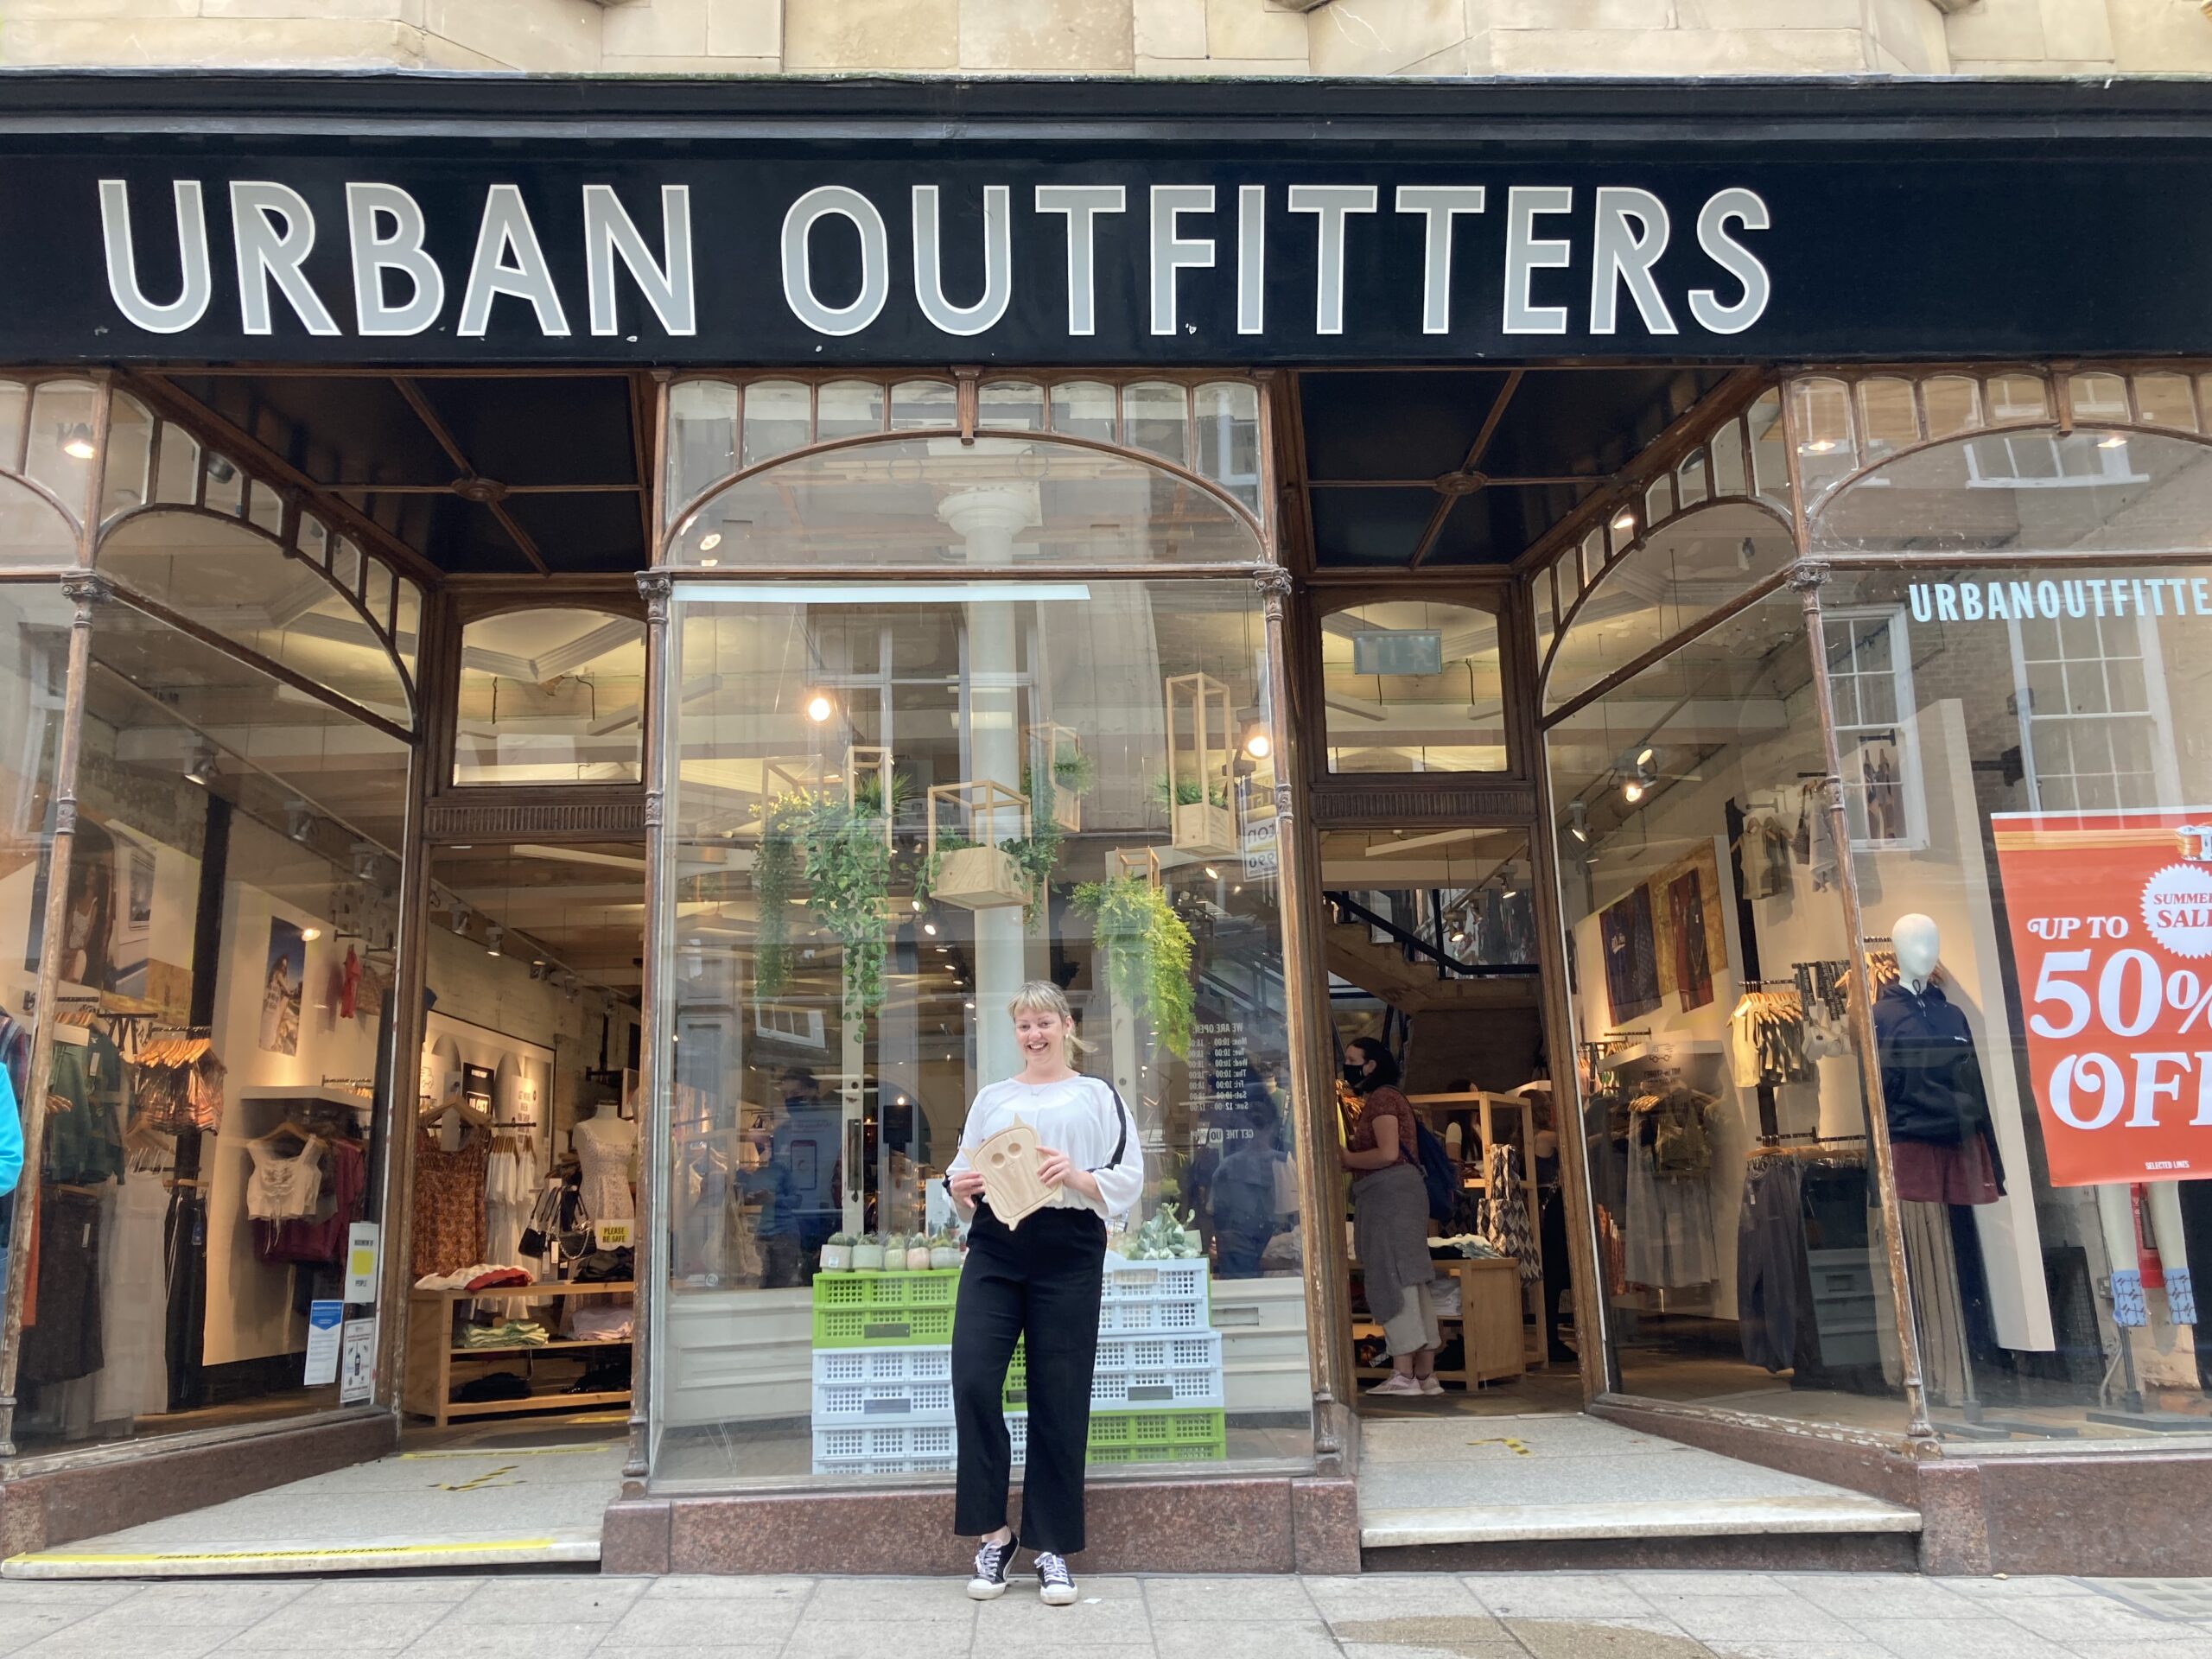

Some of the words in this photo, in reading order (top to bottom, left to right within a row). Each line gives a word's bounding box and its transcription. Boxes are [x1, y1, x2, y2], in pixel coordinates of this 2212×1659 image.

[98, 178, 697, 338] URBAN
[779, 184, 1773, 336] OUTFITTERS
[1909, 577, 2212, 623] URBANOUTFITTE
[2153, 893, 2212, 905] SUMME
[2027, 917, 2081, 940] UP
[2087, 916, 2129, 938] TO
[2030, 948, 2212, 1039] 50%
